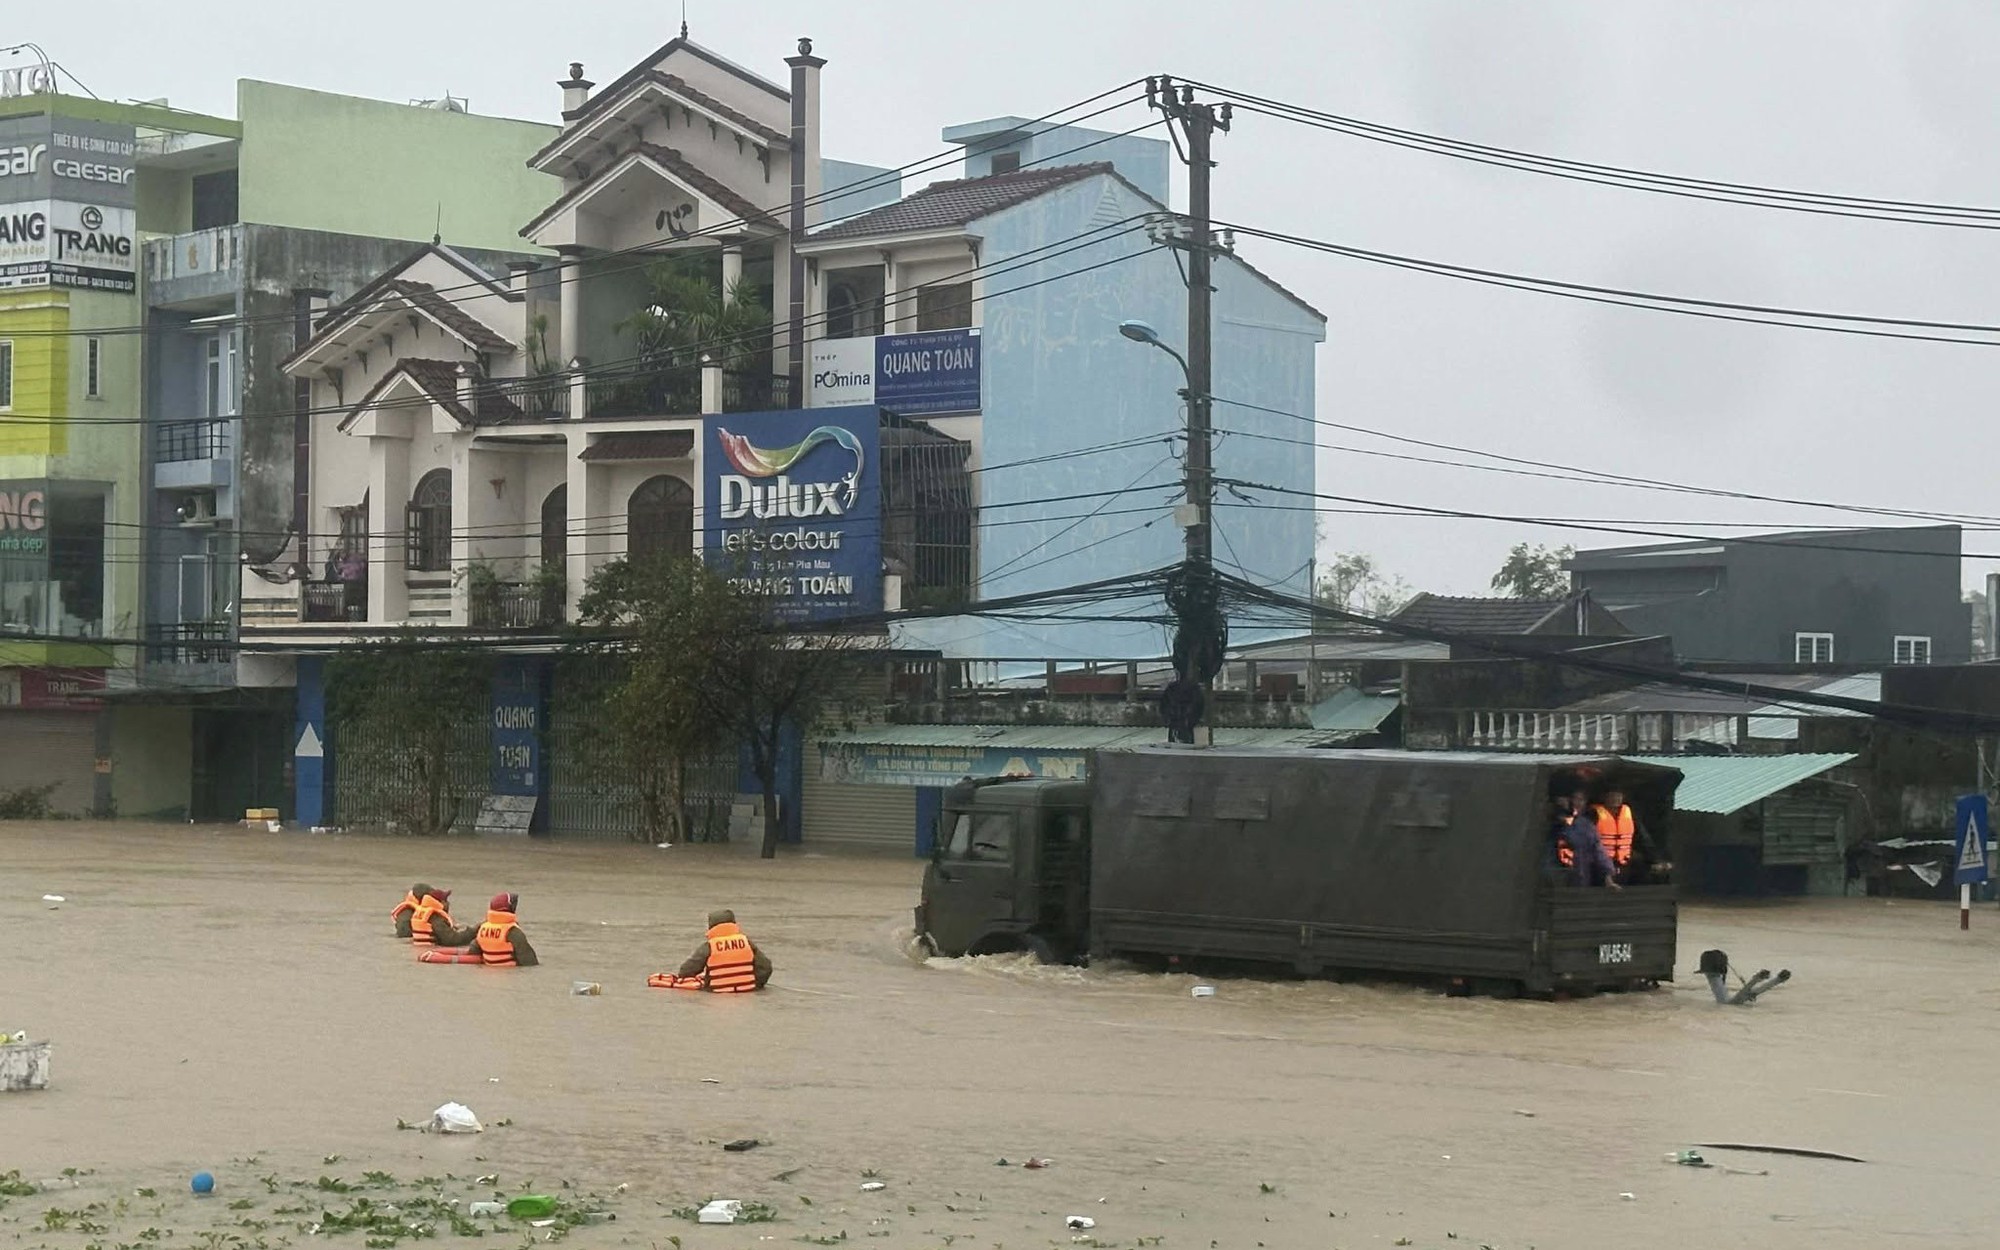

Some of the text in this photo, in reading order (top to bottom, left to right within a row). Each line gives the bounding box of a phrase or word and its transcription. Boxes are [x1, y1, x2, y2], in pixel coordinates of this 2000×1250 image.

[2, 64, 49, 98] NG
[53, 159, 135, 184] caesar
[53, 228, 131, 260] TRANG
[883, 344, 974, 378] QUANG TOÁN
[720, 475, 844, 519] Dulux
[769, 526, 844, 551] colour
[799, 571, 853, 595] TOÁN
[495, 706, 535, 730] QUANG
[480, 928, 502, 939] CAND
[716, 939, 746, 952] CAND
